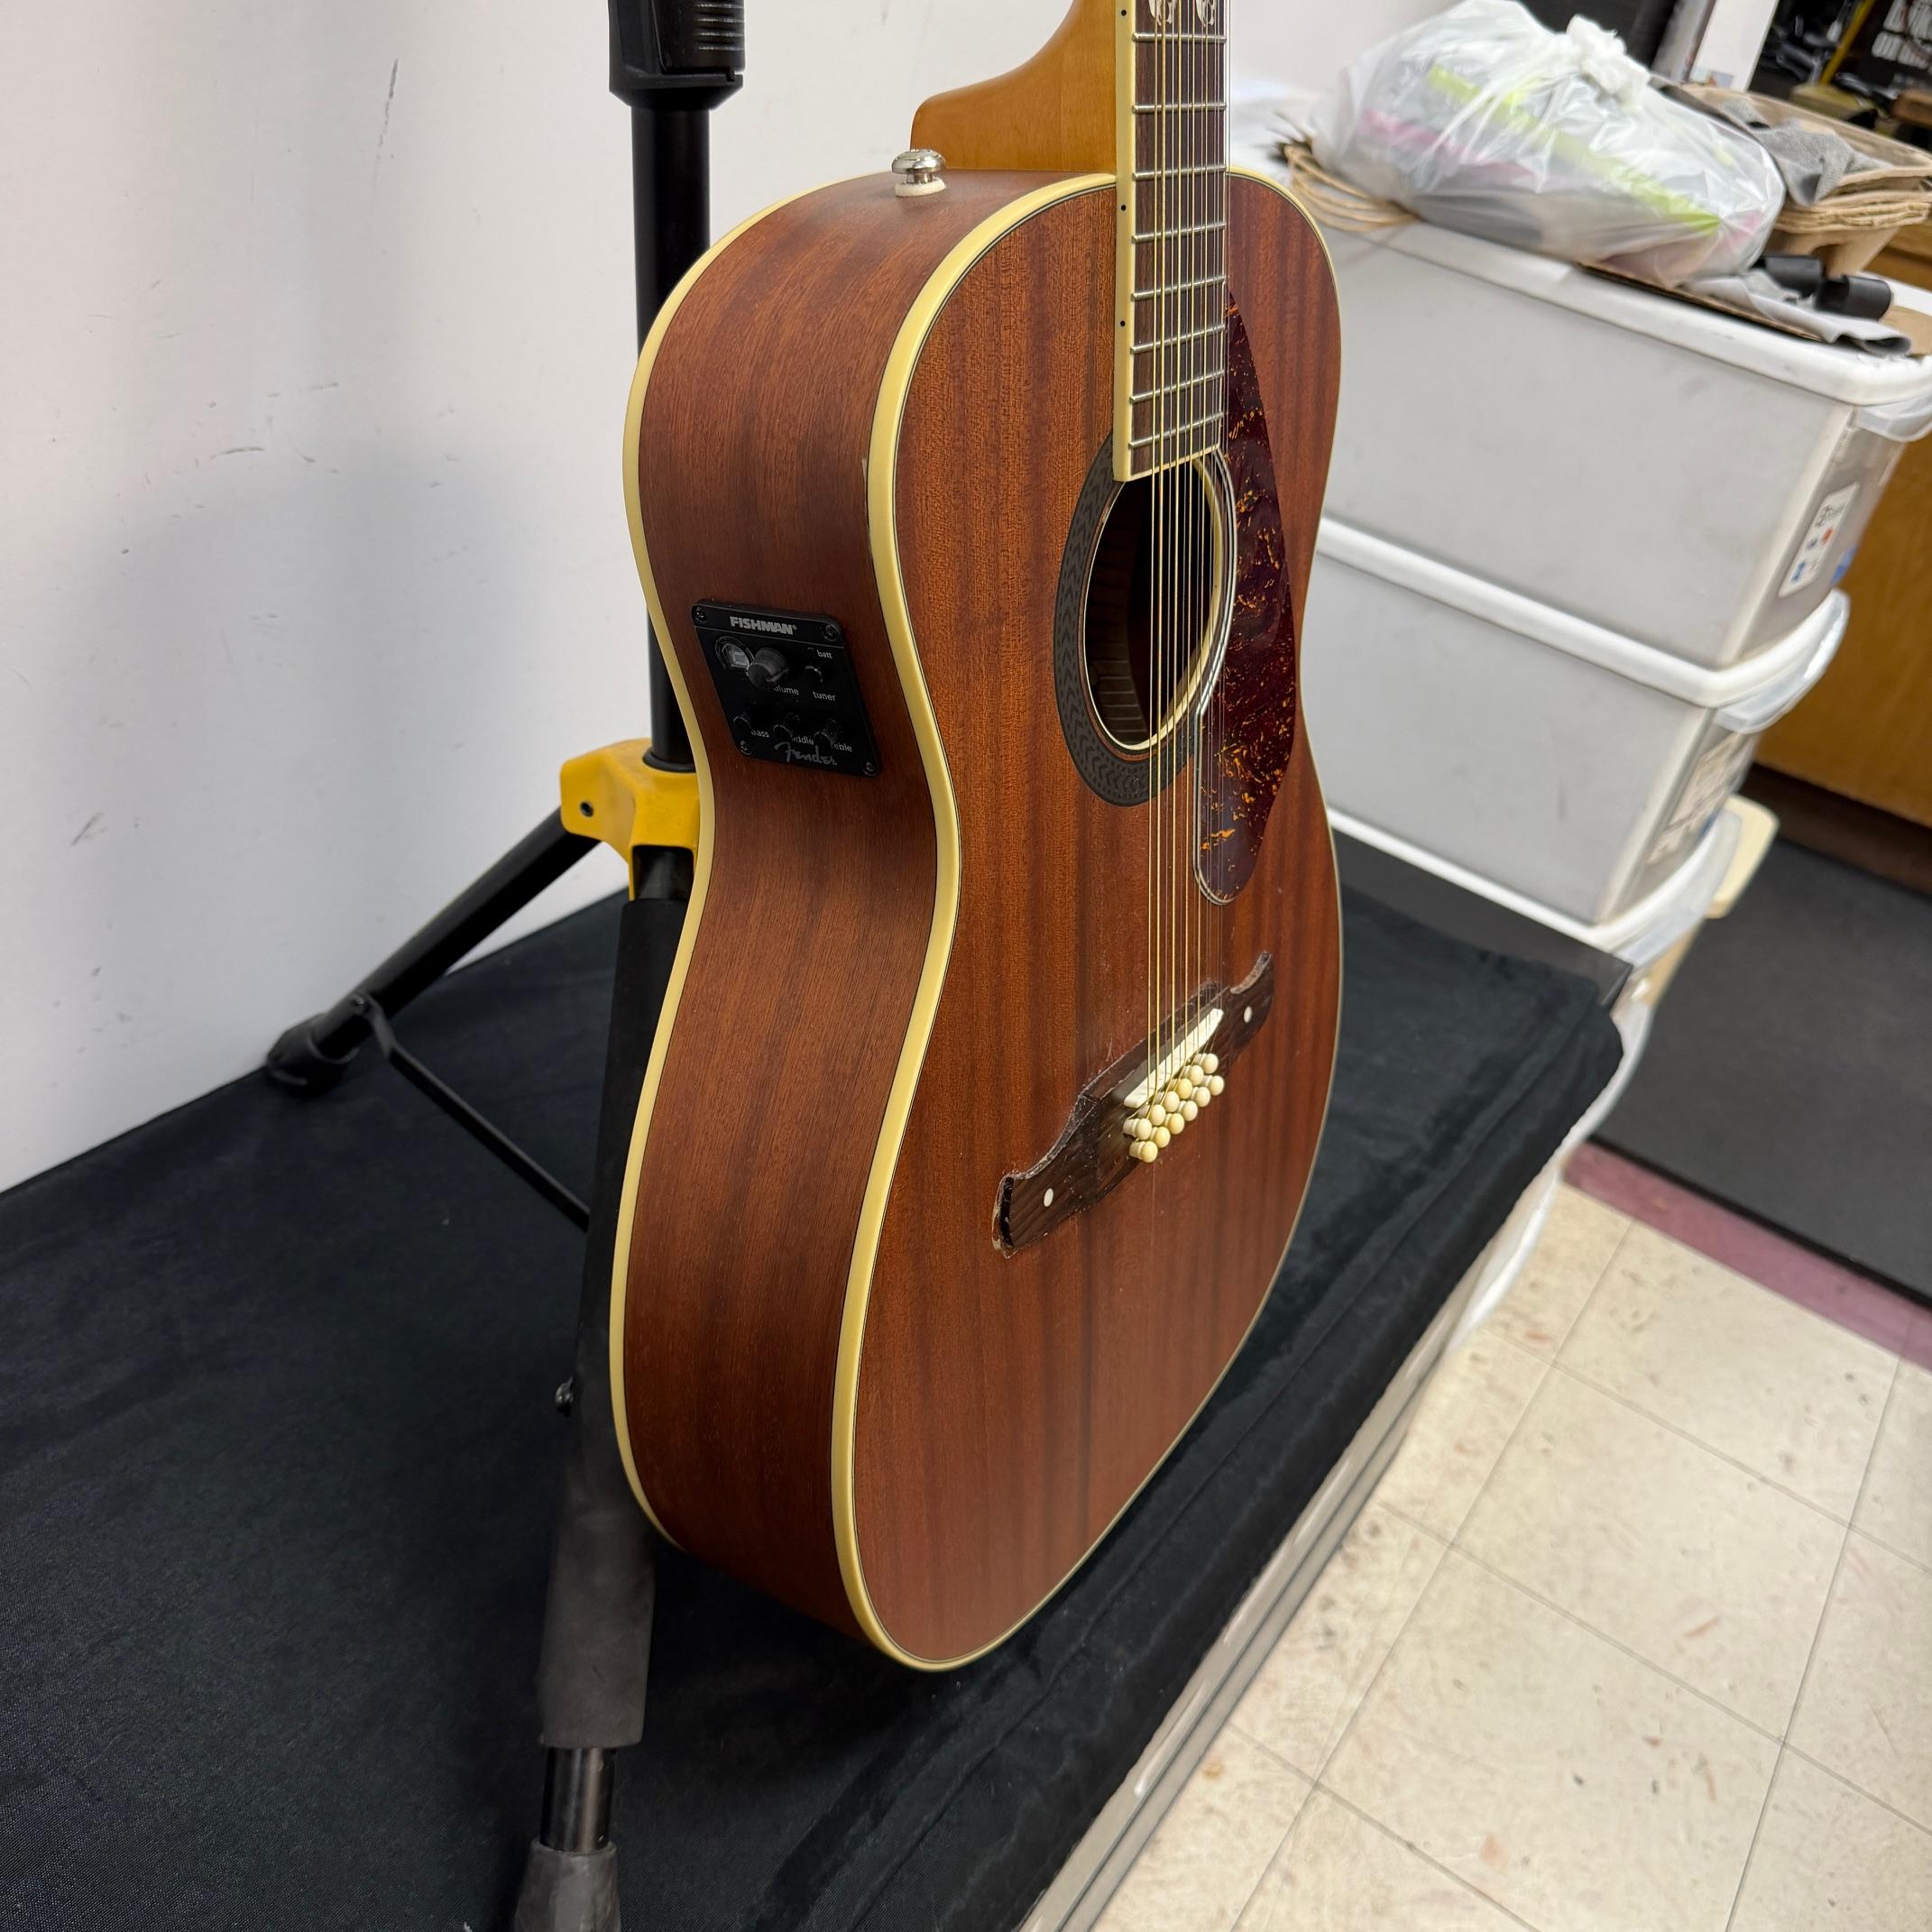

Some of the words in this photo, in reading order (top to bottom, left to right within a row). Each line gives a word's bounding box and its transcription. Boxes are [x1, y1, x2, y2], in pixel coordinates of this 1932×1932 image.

[730, 616, 794, 636] FISHMAN
[816, 649, 833, 659] batt
[773, 685, 800, 695] olume
[813, 691, 836, 702] tuner
[791, 736, 814, 746] iddle
[773, 741, 838, 766] Fender
